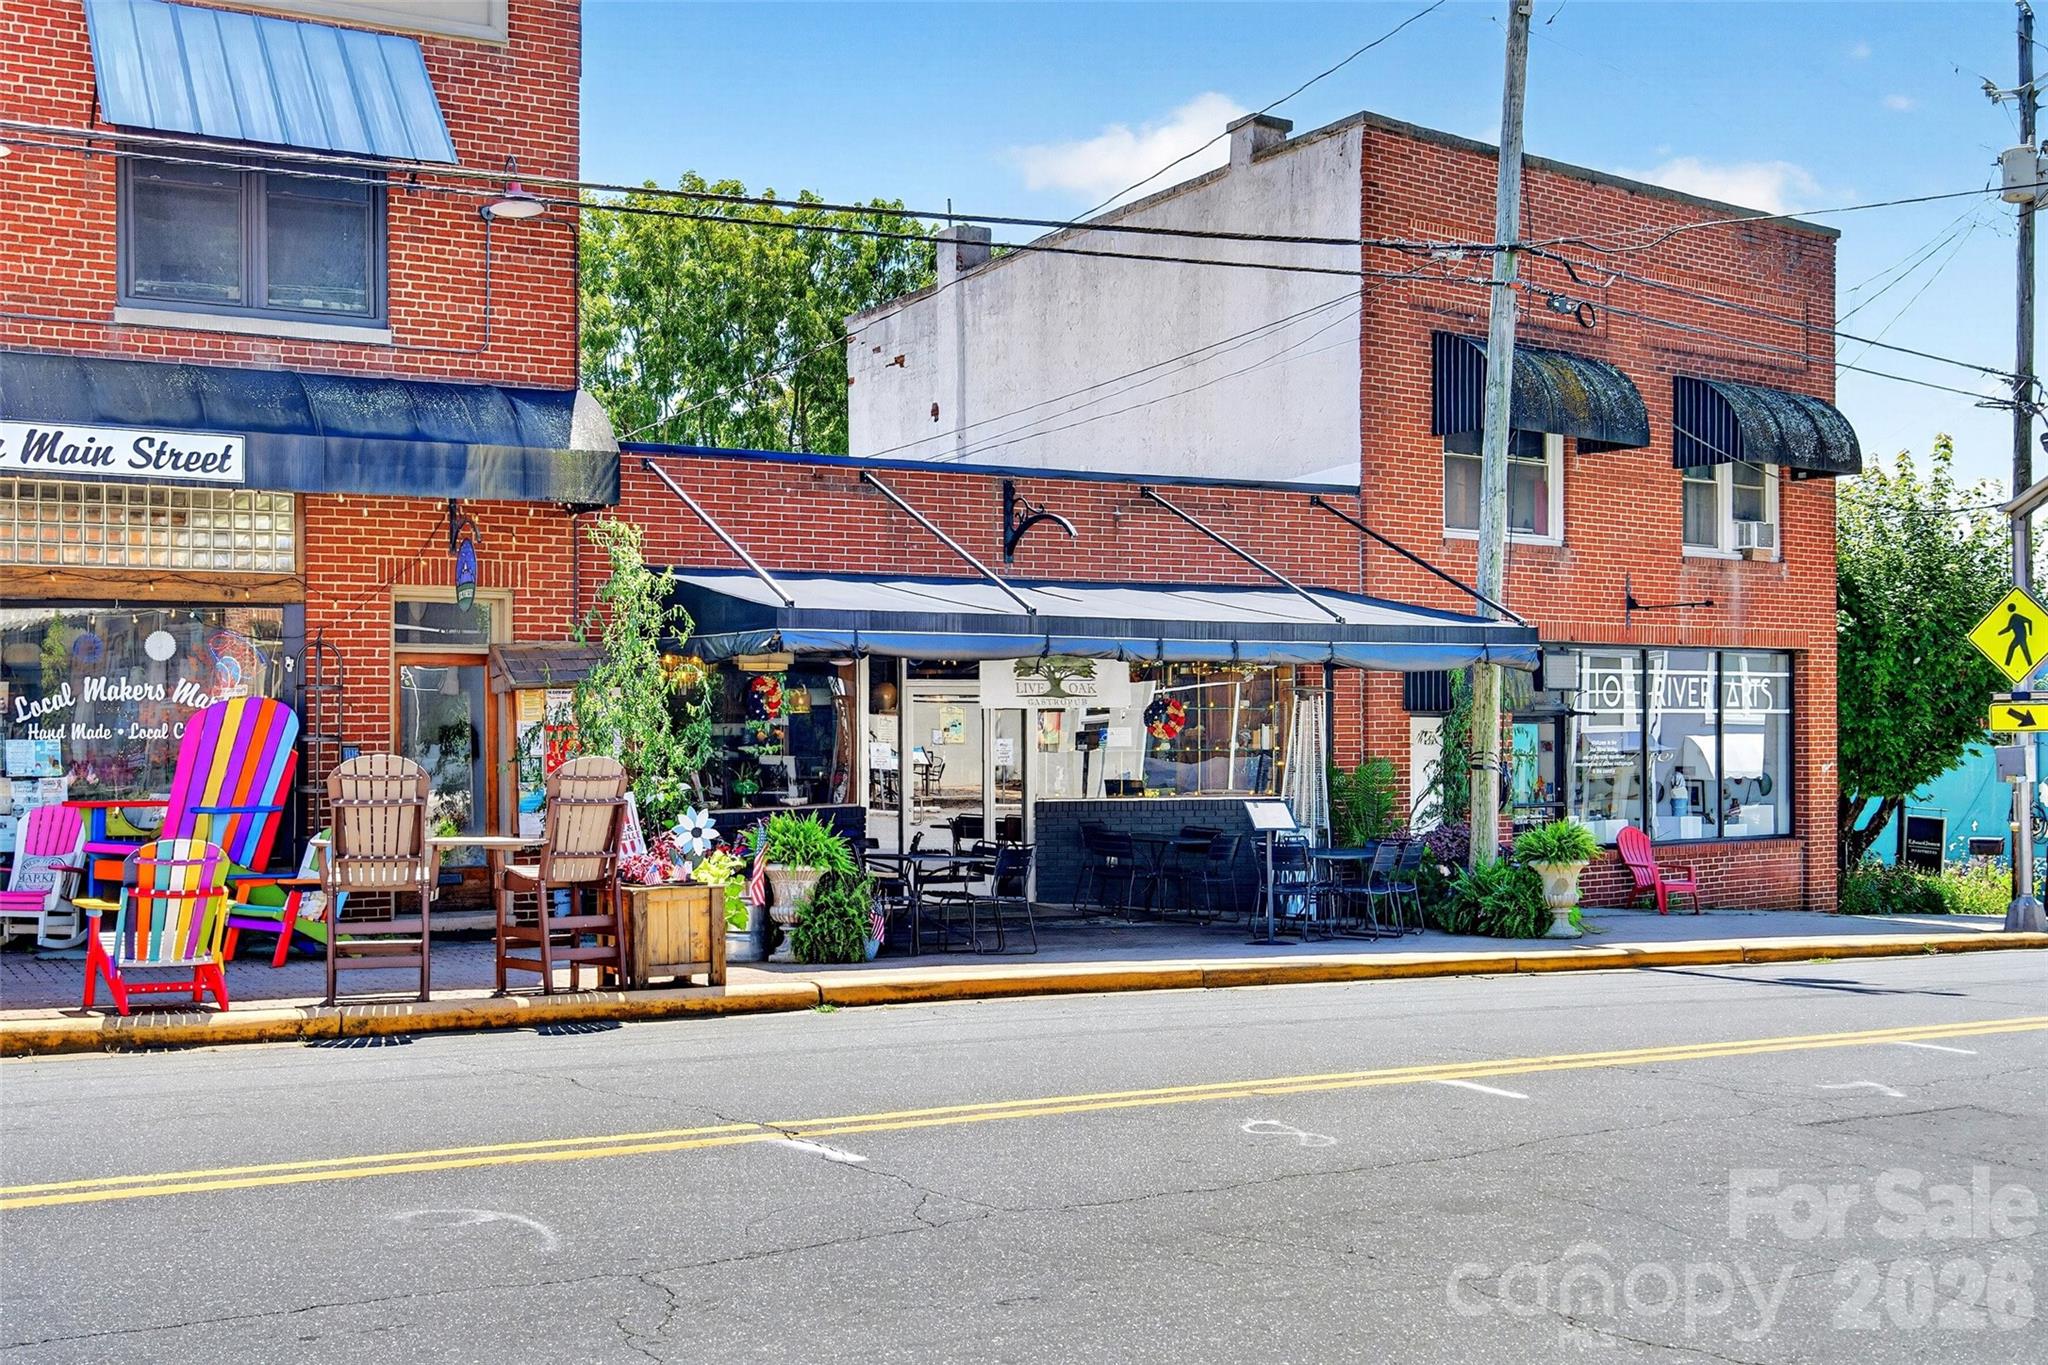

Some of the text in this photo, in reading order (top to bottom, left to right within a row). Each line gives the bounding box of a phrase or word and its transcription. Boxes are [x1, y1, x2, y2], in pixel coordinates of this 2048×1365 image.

[20, 429, 115, 467] Main
[128, 436, 233, 473] Street
[15, 682, 77, 723] Local
[83, 676, 166, 702] Makers
[1016, 682, 1097, 694] LIVE OAK
[1651, 676, 1713, 708] RIVER
[1725, 677, 1771, 710] ARTS
[1027, 698, 1088, 706] GASTROPUB
[28, 723, 66, 740] Hand
[71, 723, 112, 740] Made
[128, 723, 169, 740] Local
